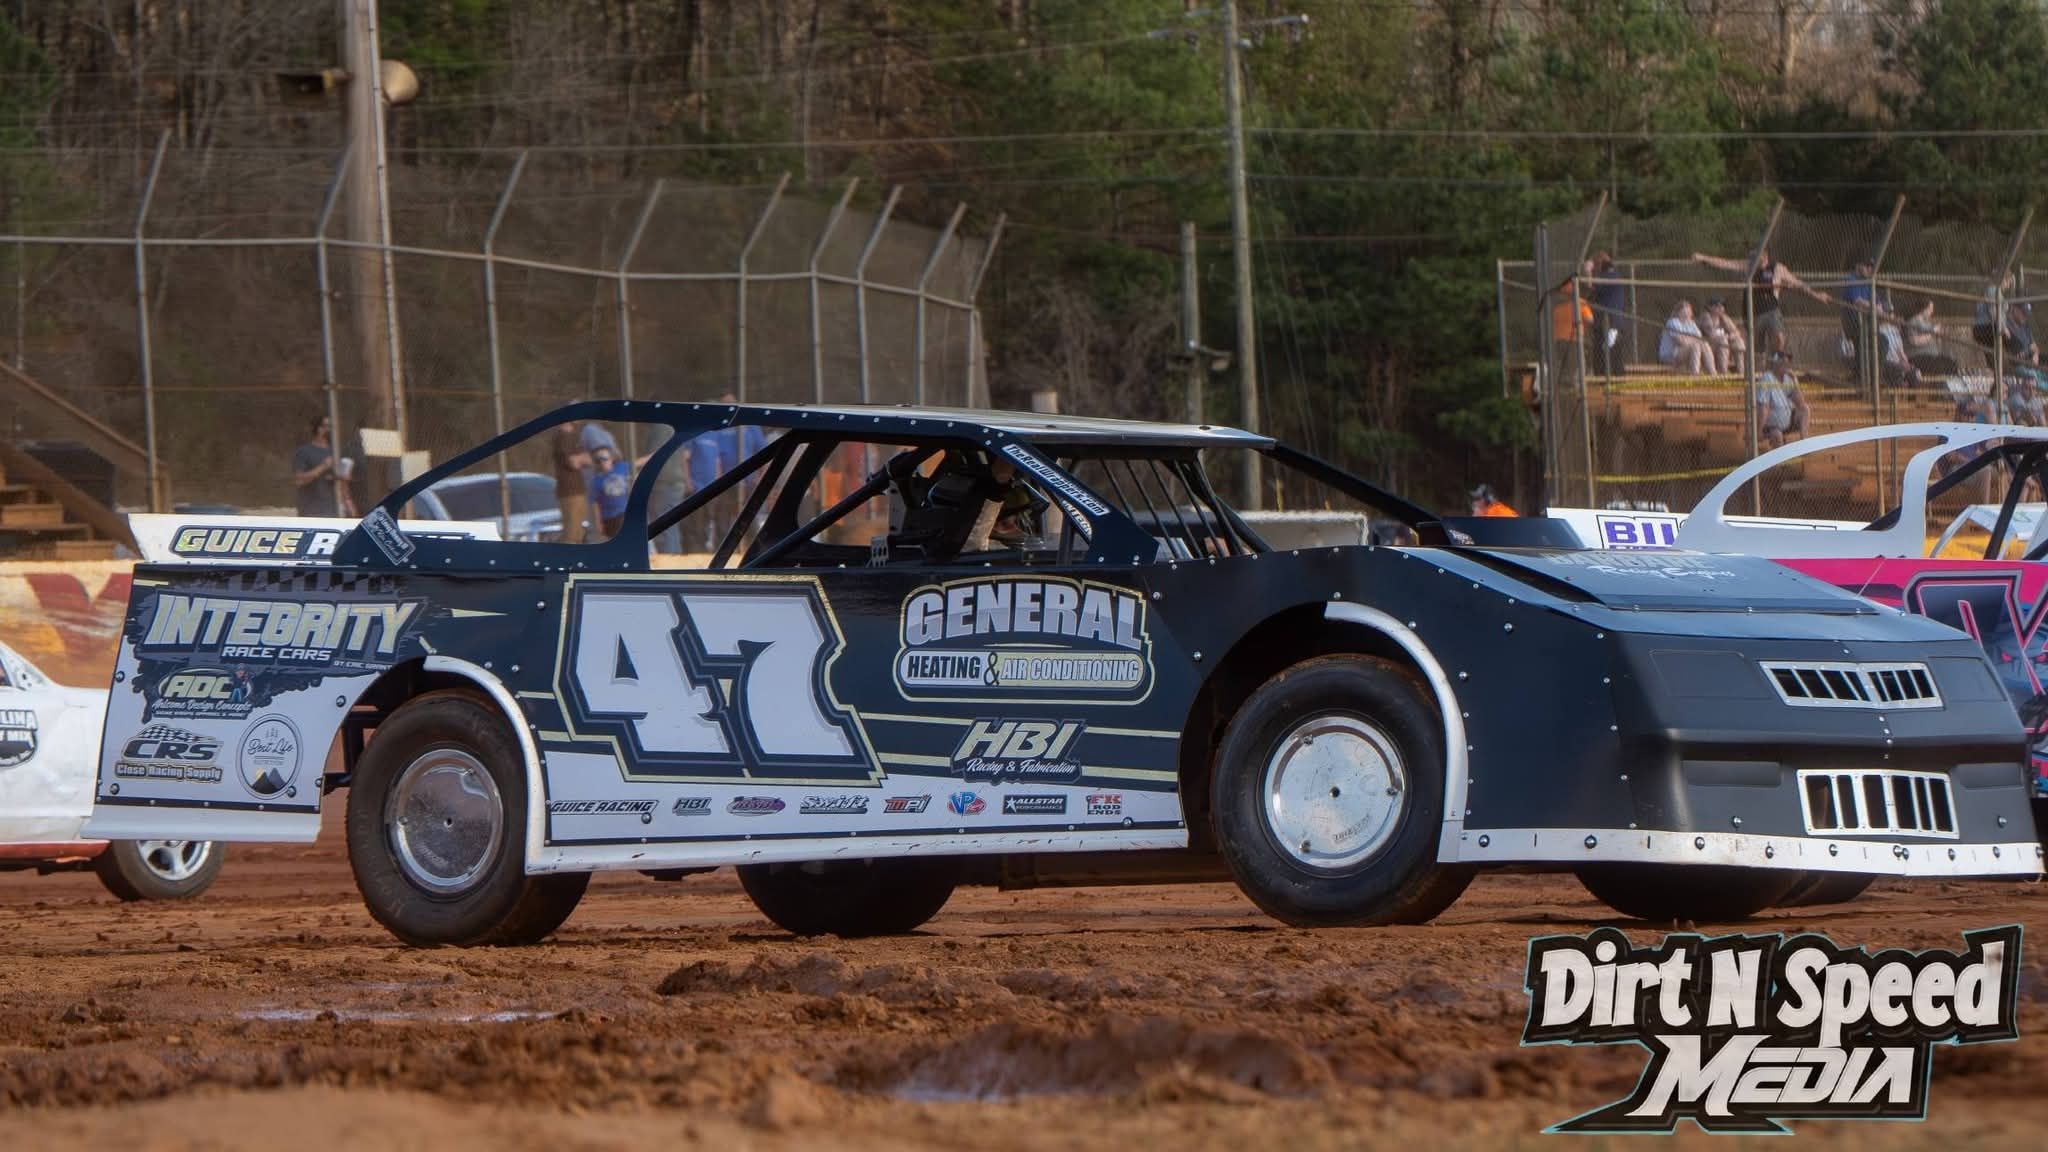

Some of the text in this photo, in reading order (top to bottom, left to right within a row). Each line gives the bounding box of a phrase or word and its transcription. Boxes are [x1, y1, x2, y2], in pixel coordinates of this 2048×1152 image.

[174, 528, 303, 553] GUICE
[144, 594, 418, 653] INTEGRITY
[906, 583, 1142, 650] GENERAL
[222, 646, 332, 661] RACE CARS
[576, 594, 855, 756] 47
[907, 651, 1139, 686] HEATING & AIR CONDITIONING
[123, 740, 218, 760] CRS
[954, 721, 1079, 761] HBI
[148, 765, 184, 779] Racing
[186, 766, 222, 781] Supply
[966, 758, 1077, 774] Racing & Fabrication
[551, 801, 653, 812] GUICE RACING
[673, 798, 711, 809] HBI
[951, 791, 977, 815] VP
